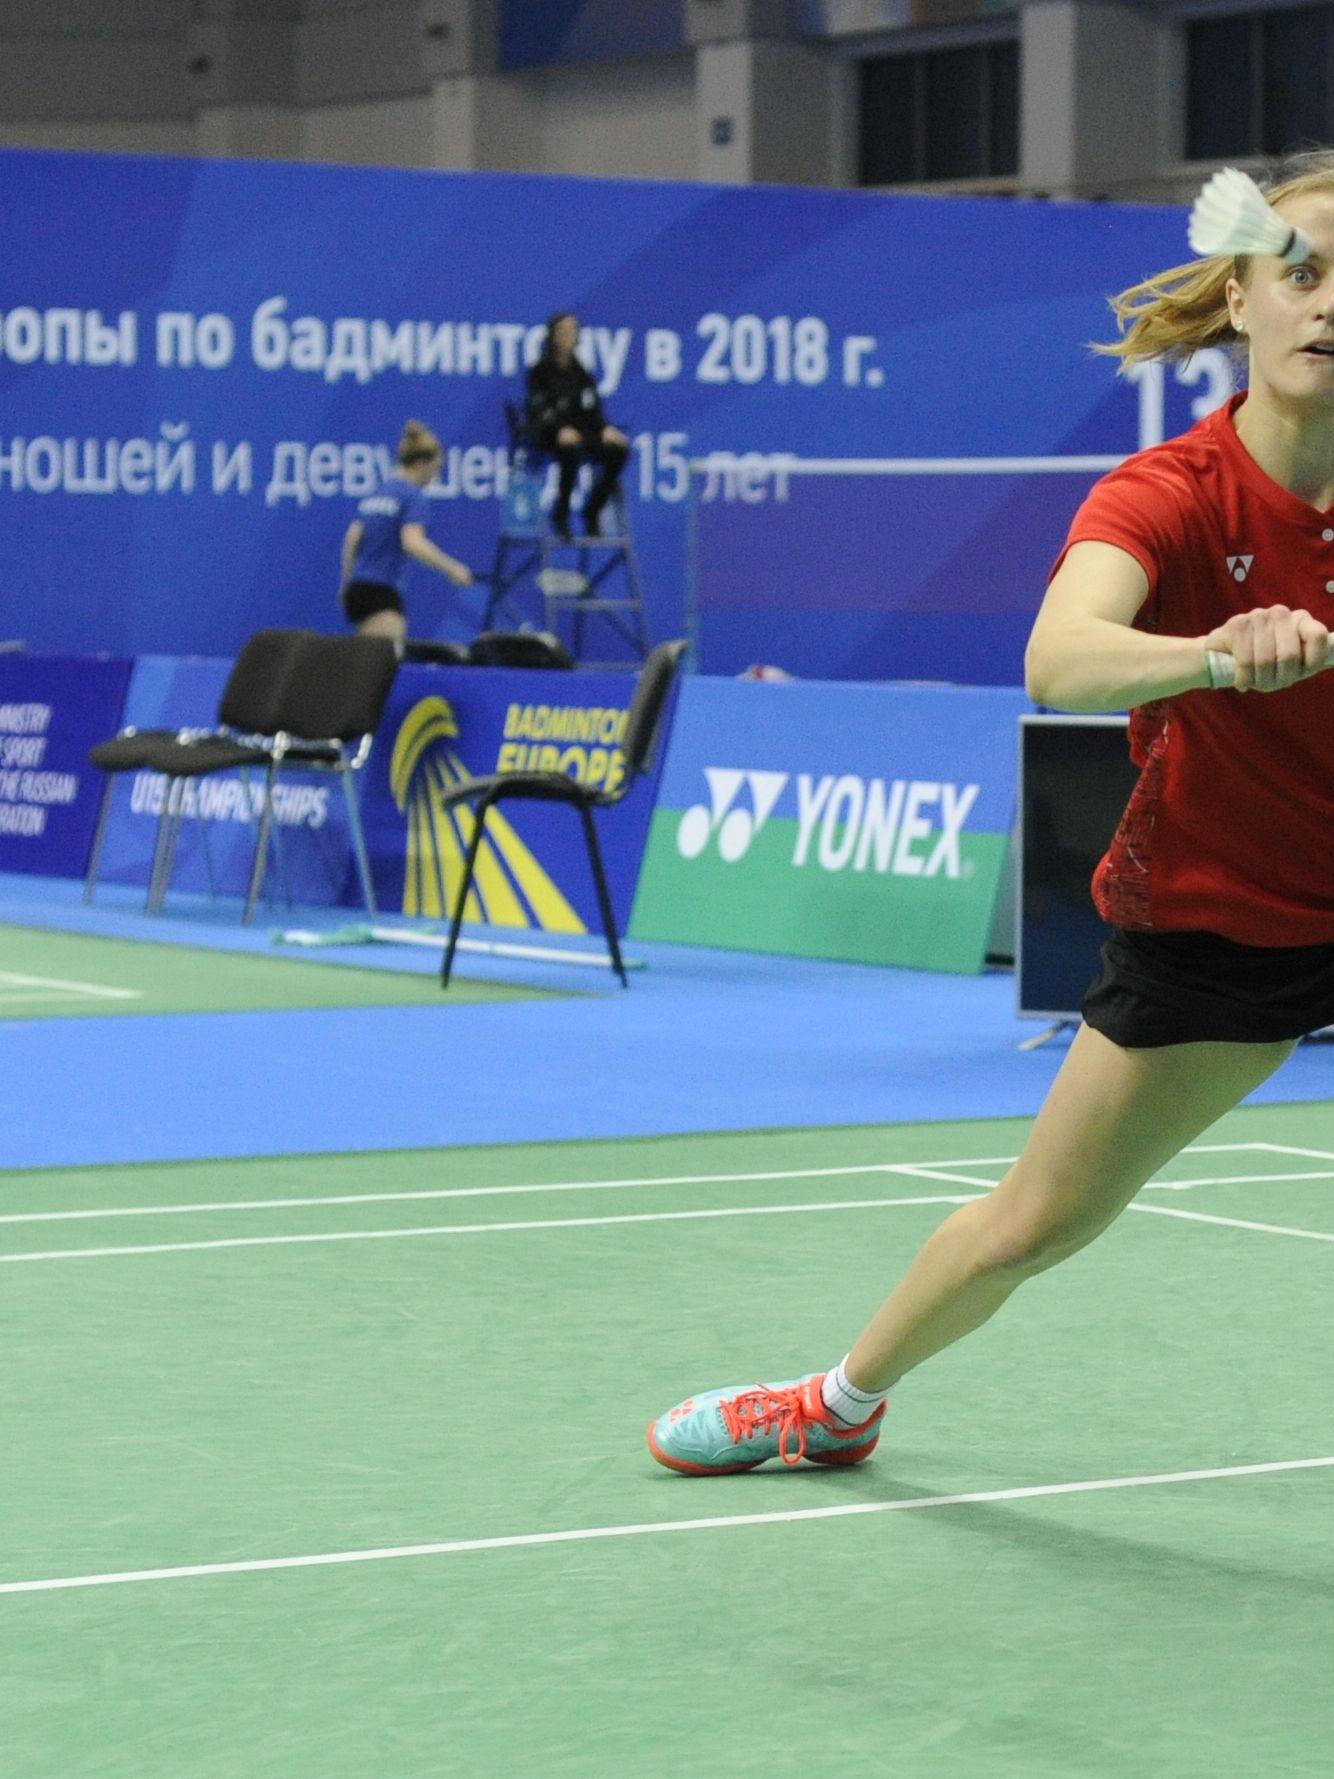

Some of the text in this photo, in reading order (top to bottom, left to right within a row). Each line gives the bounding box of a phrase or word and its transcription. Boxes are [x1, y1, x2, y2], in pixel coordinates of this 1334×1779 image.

[0, 305, 138, 368] опы
[156, 311, 235, 370] по
[644, 328, 682, 383] в
[696, 312, 828, 387] 2018
[842, 335, 884, 388] г.
[212, 440, 253, 495] и
[633, 432, 690, 503] 15
[791, 773, 979, 879] YONEX
